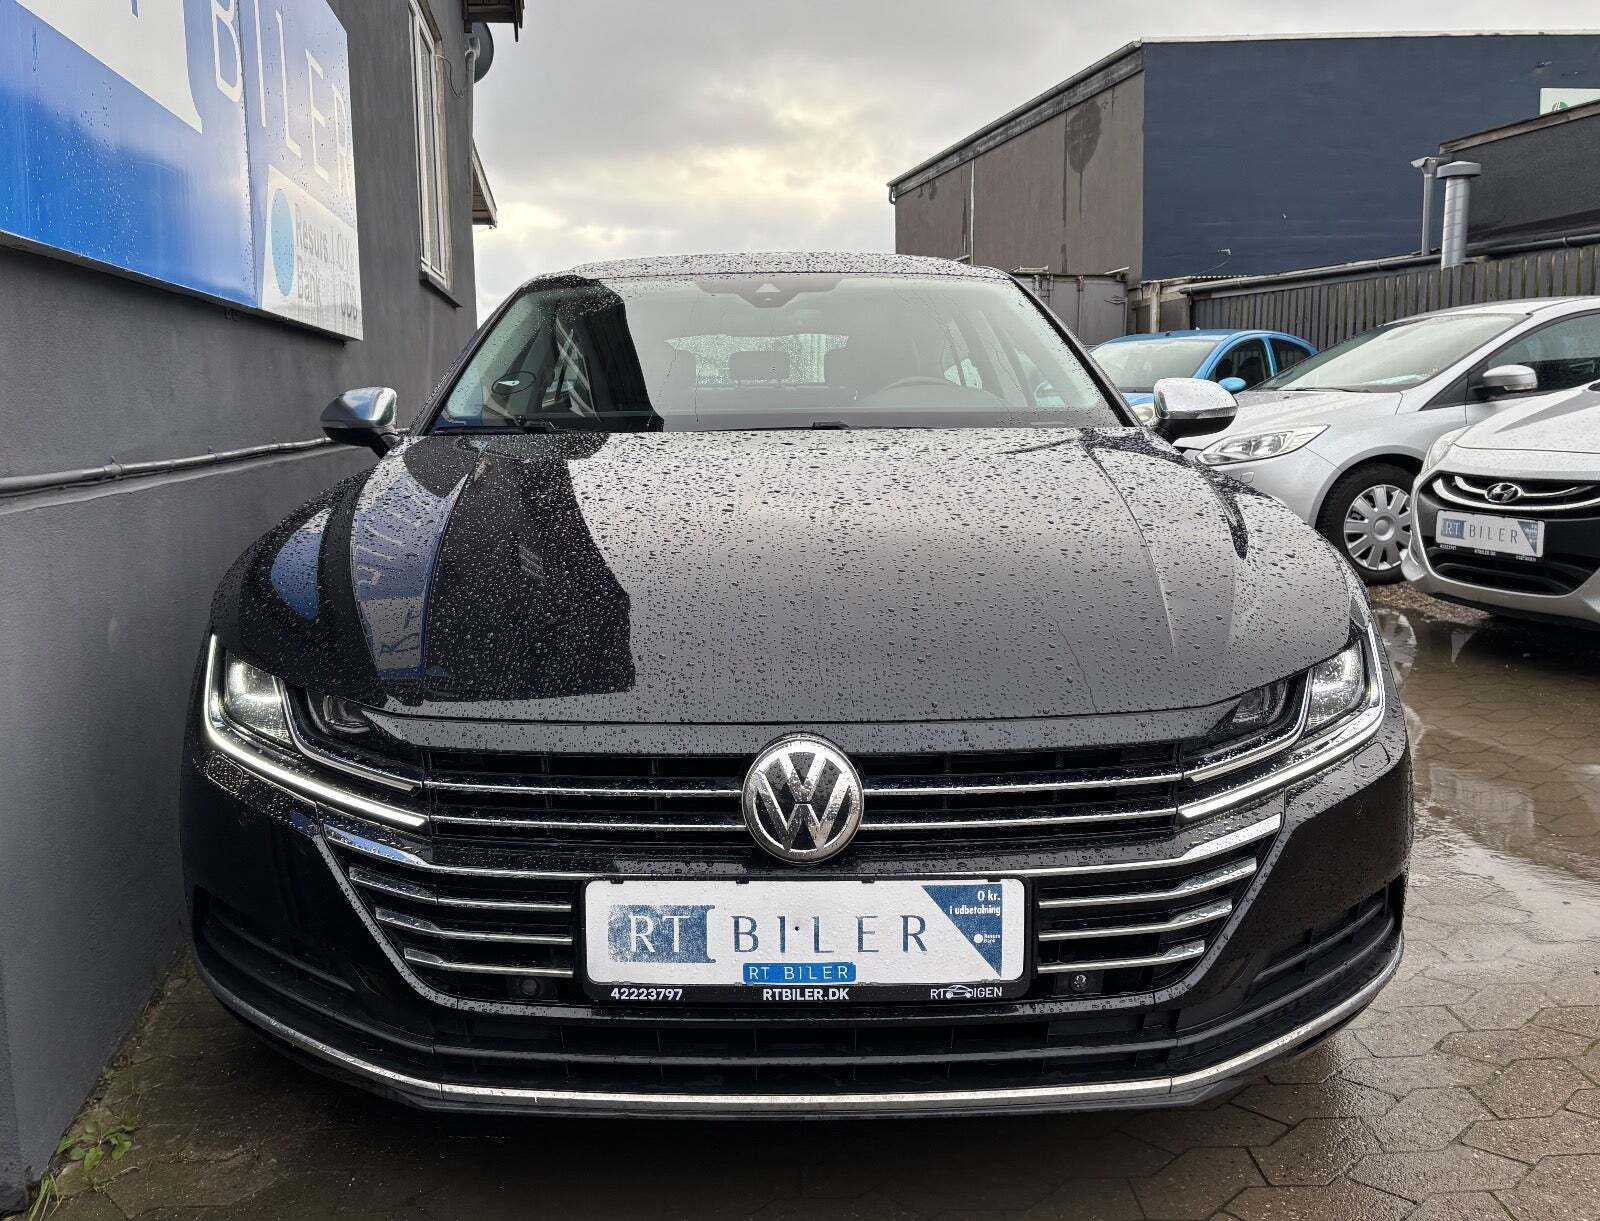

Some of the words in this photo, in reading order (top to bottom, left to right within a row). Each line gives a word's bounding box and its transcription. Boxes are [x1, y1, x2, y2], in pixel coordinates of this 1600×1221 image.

[210, 0, 352, 198] BILER
[297, 255, 322, 308] Bank
[1446, 521, 1460, 536] RT
[1469, 524, 1518, 545] BILER
[988, 890, 1001, 901] kr.
[629, 914, 692, 954] RT
[731, 914, 928, 953] BILER
[748, 967, 770, 980] RT
[785, 965, 849, 980] BILER
[611, 987, 683, 1000] 42223797
[762, 988, 850, 1001] RTBILER.DK
